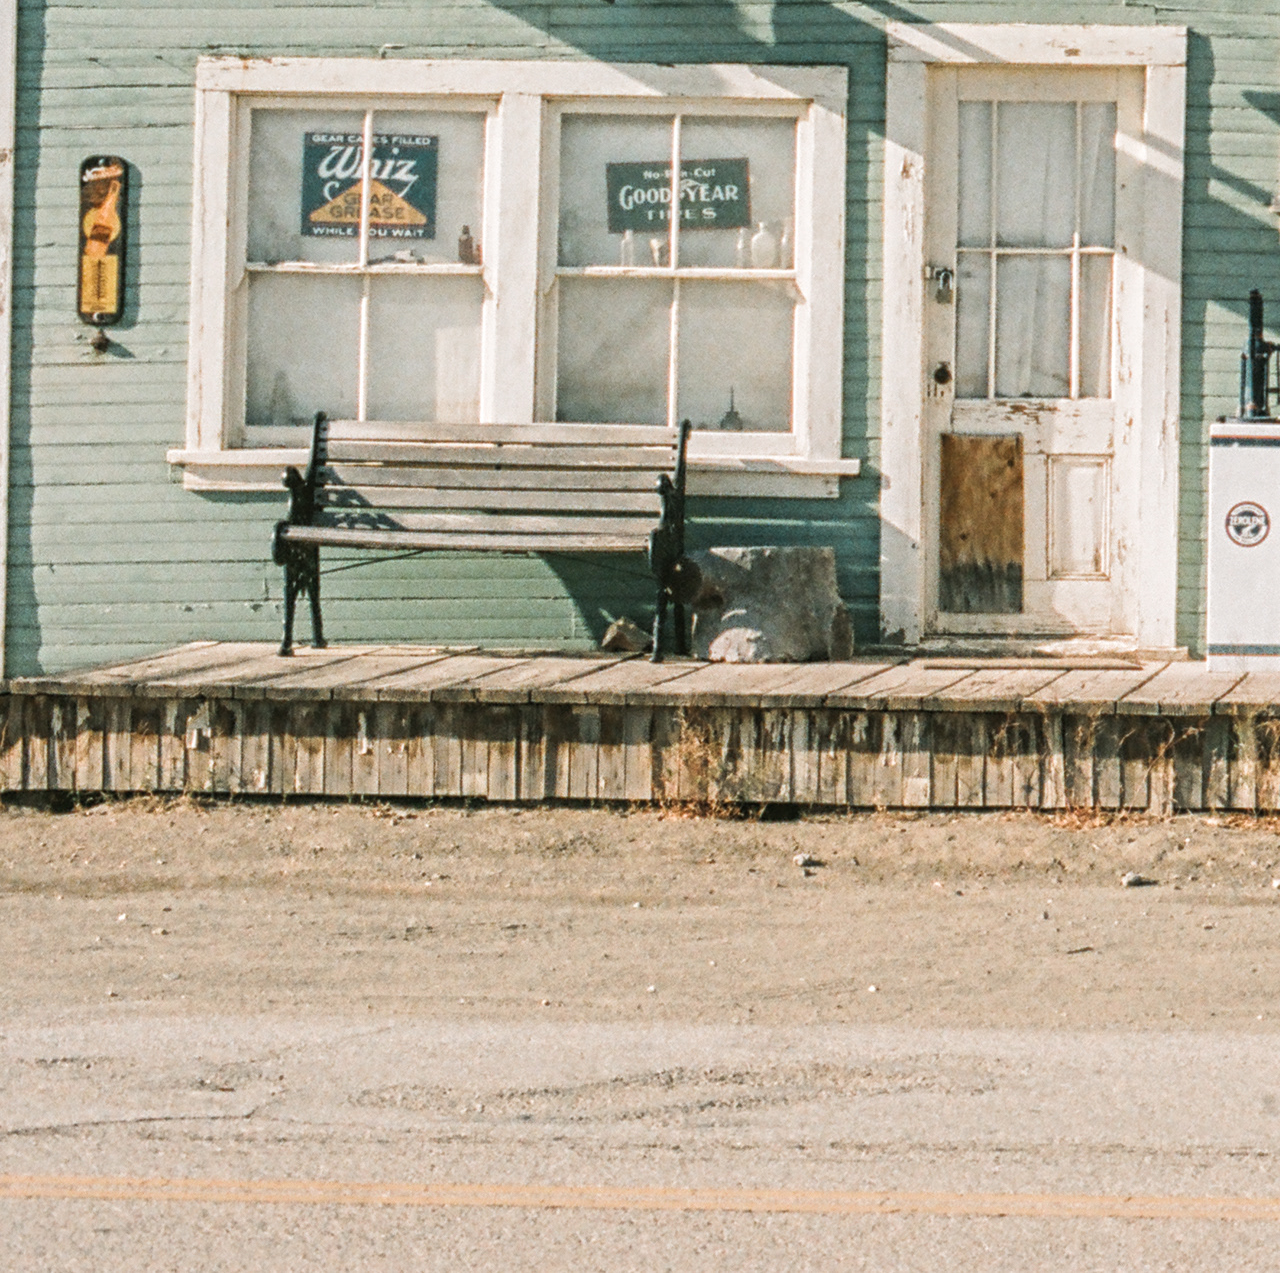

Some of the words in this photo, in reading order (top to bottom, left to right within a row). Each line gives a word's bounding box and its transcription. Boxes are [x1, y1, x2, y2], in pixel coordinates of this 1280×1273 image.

[312, 134, 344, 143] GEAR
[347, 135, 389, 144] CAES
[392, 136, 432, 146] FILLED
[645, 207, 718, 221] TIES
[312, 227, 354, 236] WHILE
[360, 228, 388, 237] OU
[391, 229, 425, 237] WAIT
